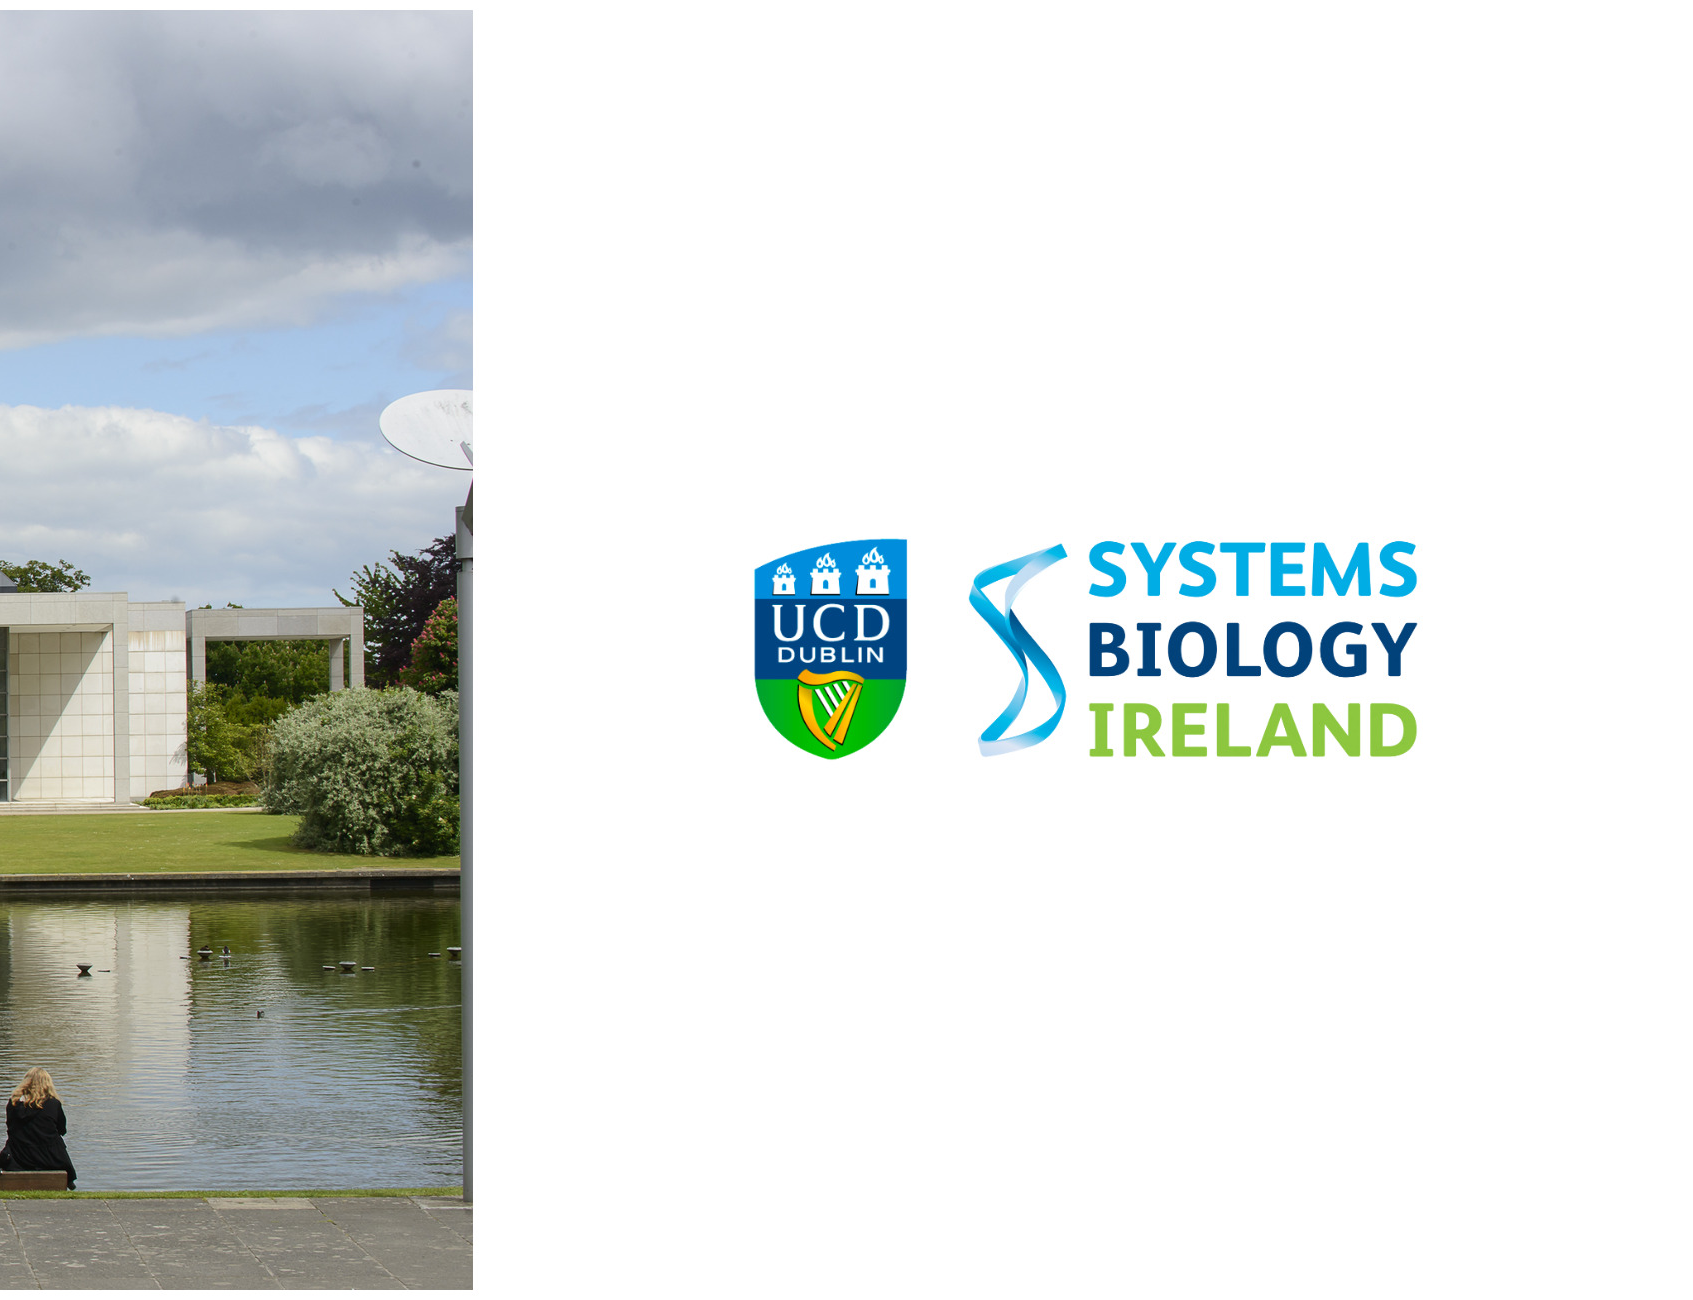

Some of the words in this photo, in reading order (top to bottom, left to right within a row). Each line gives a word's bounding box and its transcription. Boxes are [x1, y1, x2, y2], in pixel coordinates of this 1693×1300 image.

[1089, 541, 1417, 597] SYSTEMS
[772, 604, 890, 642] UCD
[1089, 621, 1417, 677] BIOLOGY
[778, 647, 884, 664] DUBLIN
[1089, 703, 1417, 757] IRELAND
